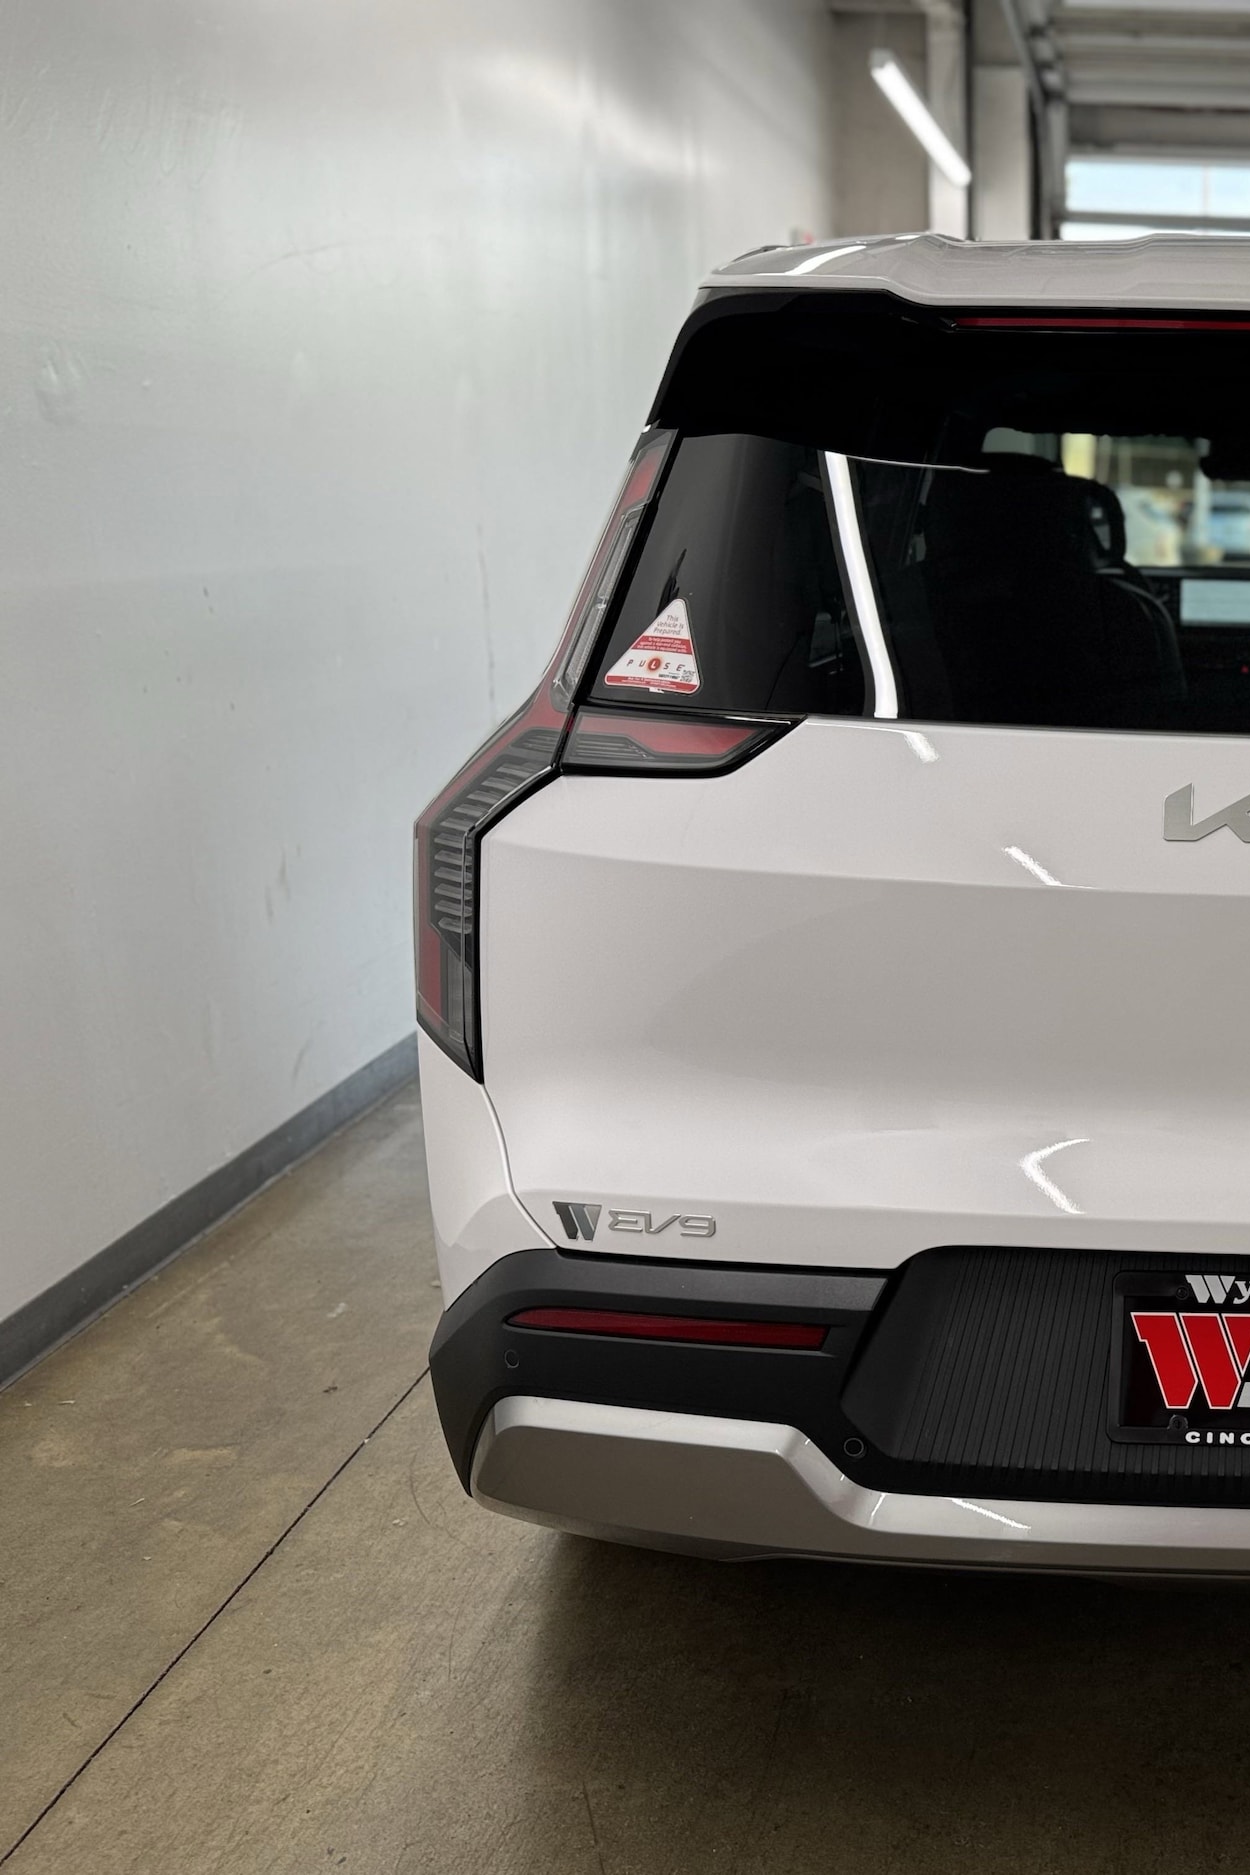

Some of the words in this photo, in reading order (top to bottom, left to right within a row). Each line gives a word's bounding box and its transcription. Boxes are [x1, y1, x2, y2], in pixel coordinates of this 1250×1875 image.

[666, 614, 679, 622] This
[626, 659, 686, 672] PULSE
[608, 1208, 716, 1237] EV9
